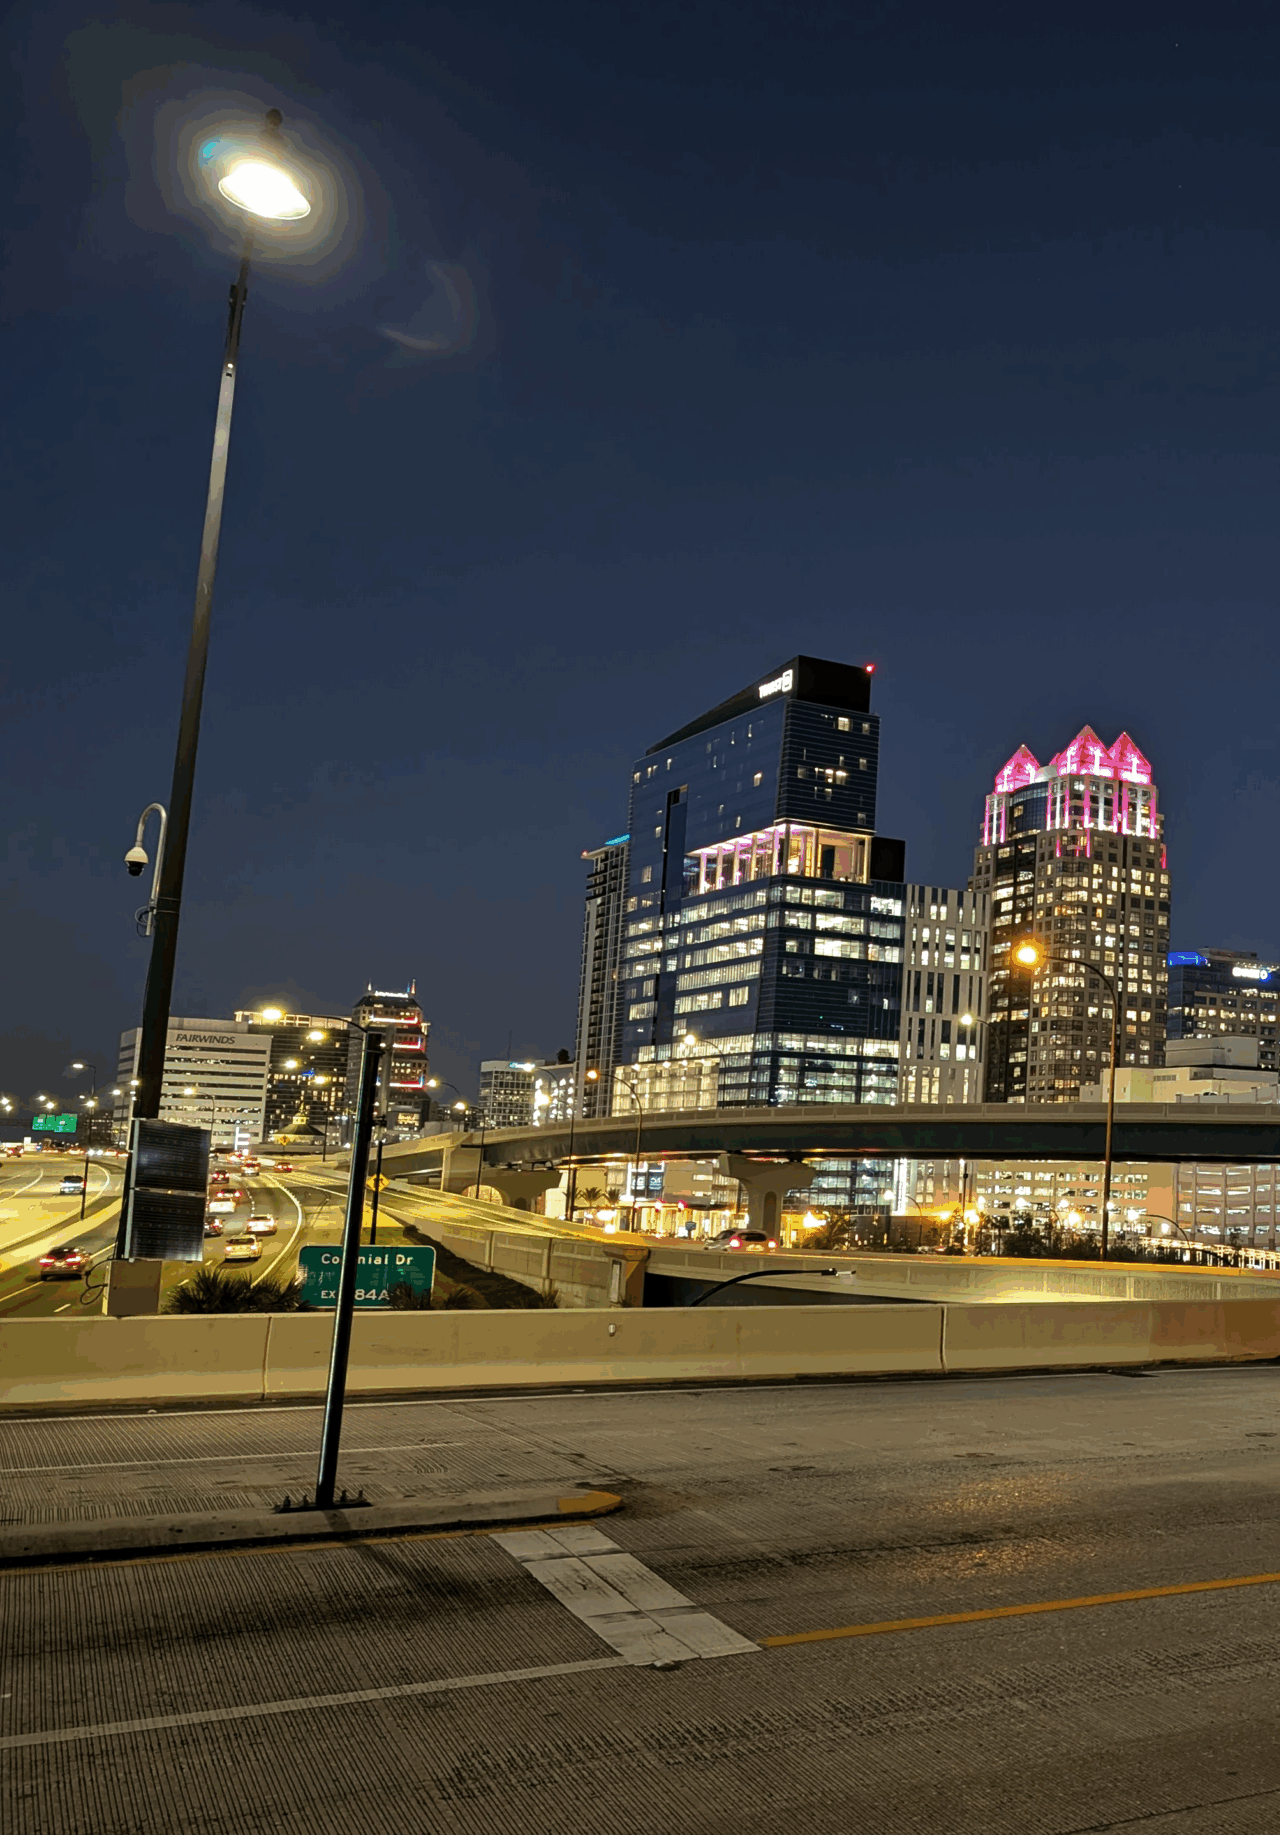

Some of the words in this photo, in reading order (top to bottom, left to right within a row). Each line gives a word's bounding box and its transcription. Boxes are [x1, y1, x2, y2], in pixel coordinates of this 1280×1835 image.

[175, 1033, 236, 1045] FAIRWINDS
[321, 1253, 389, 1265] Conial
[395, 1254, 414, 1265] Dr
[354, 1288, 390, 1301] 84A
